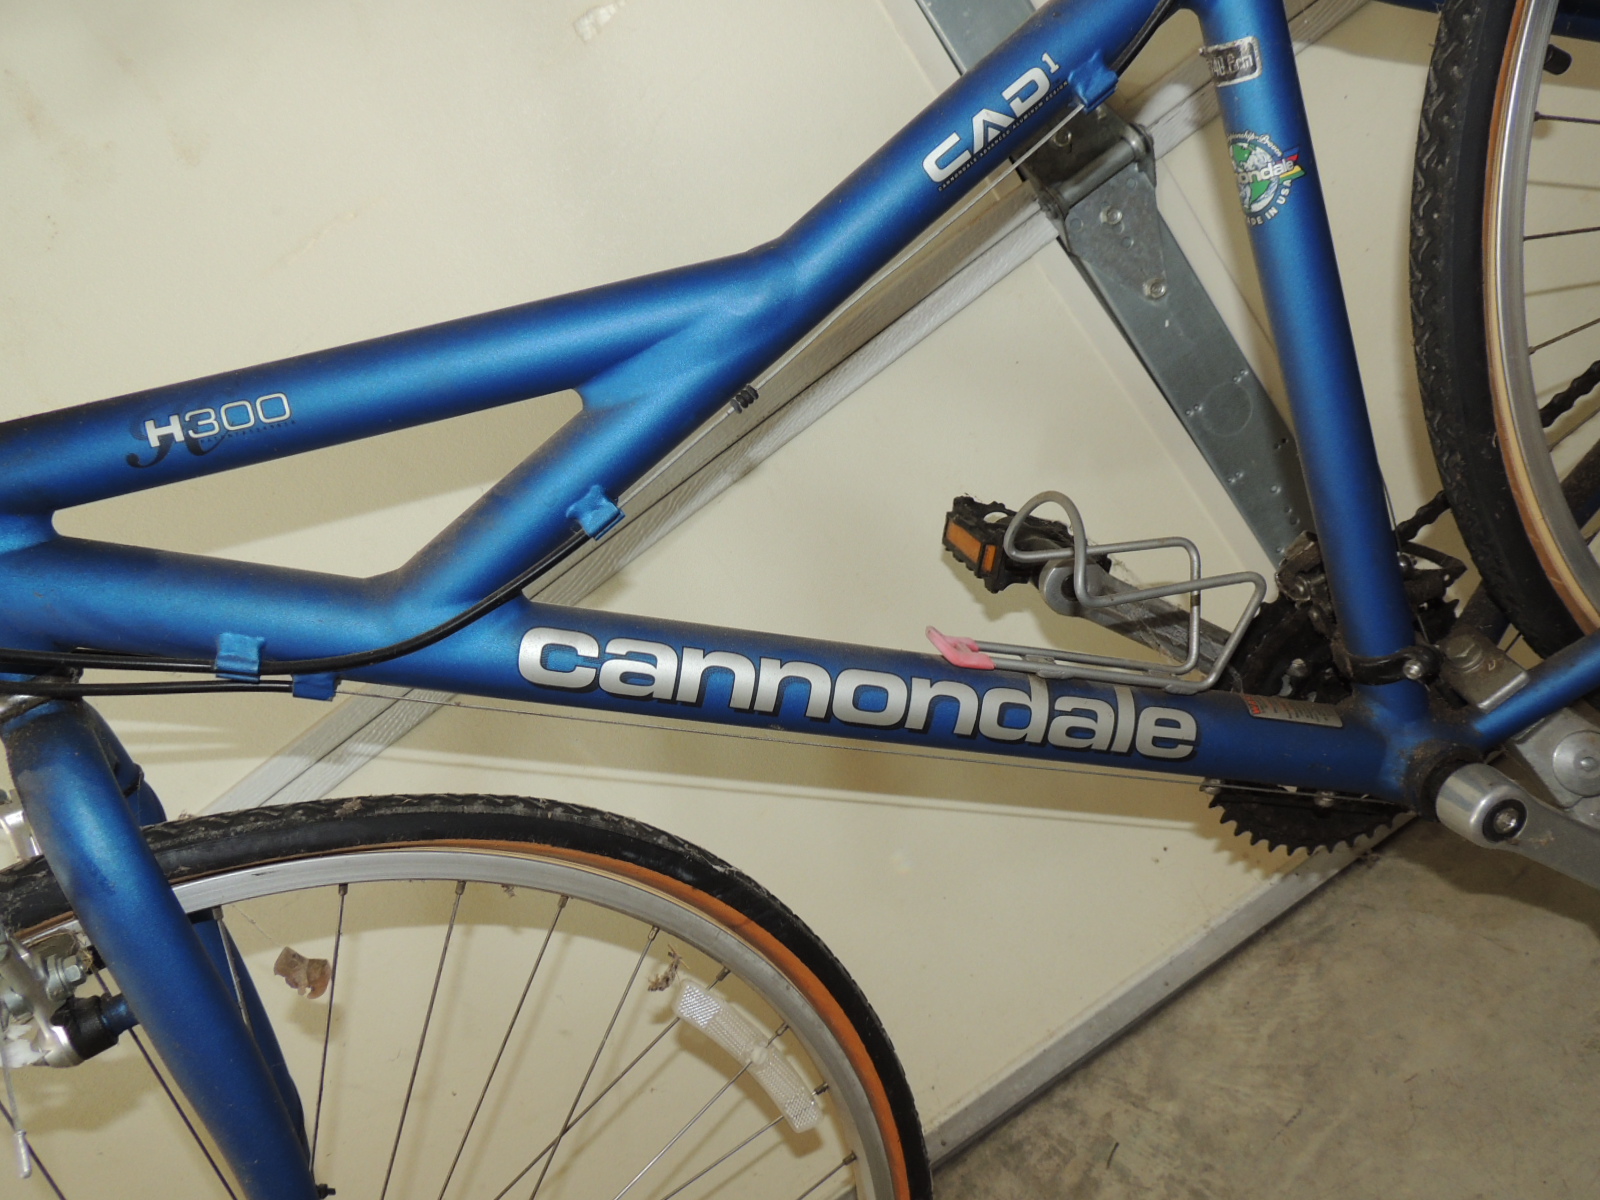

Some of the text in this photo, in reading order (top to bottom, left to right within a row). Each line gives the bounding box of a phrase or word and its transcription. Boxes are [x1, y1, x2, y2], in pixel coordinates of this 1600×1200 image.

[1237, 158, 1294, 184] ondale
[1264, 206, 1279, 220] IN
[1276, 179, 1292, 205] USA
[144, 392, 292, 448] H300
[517, 625, 1199, 760] cannondale
